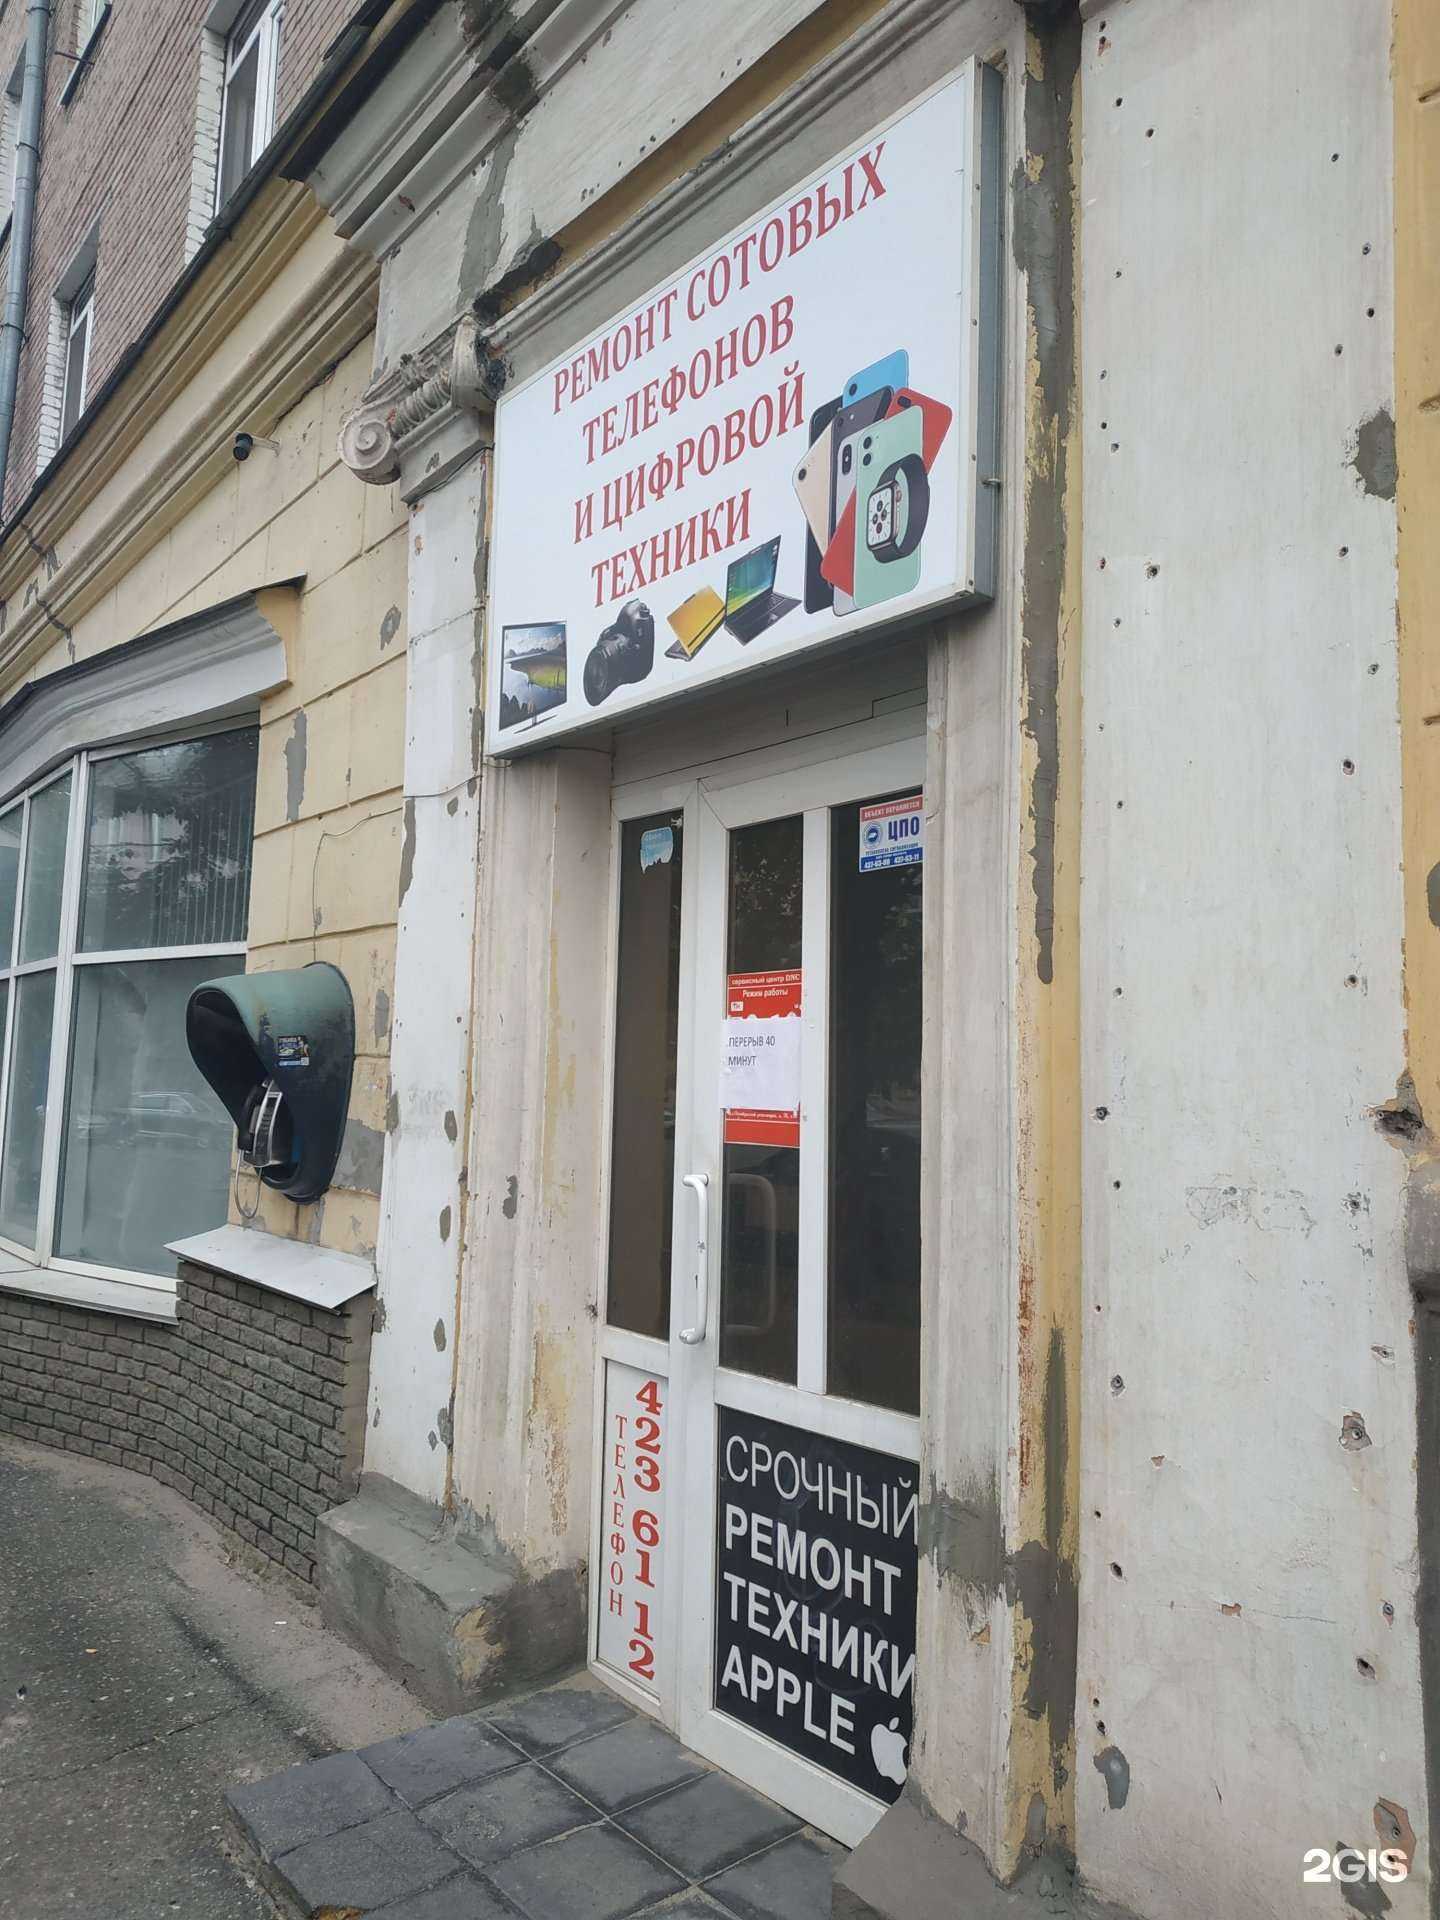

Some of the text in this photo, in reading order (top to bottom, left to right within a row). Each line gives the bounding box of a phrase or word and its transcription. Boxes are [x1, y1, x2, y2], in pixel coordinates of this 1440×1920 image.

[553, 142, 887, 415] РЕМОНТ СОТОВЫХ
[582, 295, 796, 465] ТЕЛЕФОНОВ
[574, 360, 807, 545] И ЦИФРОВОЙ
[591, 489, 752, 608] ТЕХНИКИ
[888, 816, 920, 841] ЦПО
[731, 976, 765, 986] сервисный
[766, 976, 784, 985] центр
[742, 988, 789, 999] Режим работы
[728, 1035, 776, 1048] ПЕРЕРЫВ 40
[728, 1056, 757, 1066] МИНУТ
[725, 1435, 919, 1546] СРОЧНЫЙ
[725, 1503, 901, 1616] РЕМОНТ
[723, 1571, 917, 1699] ТЕХНИКИ
[721, 1645, 856, 1755] APPLE
